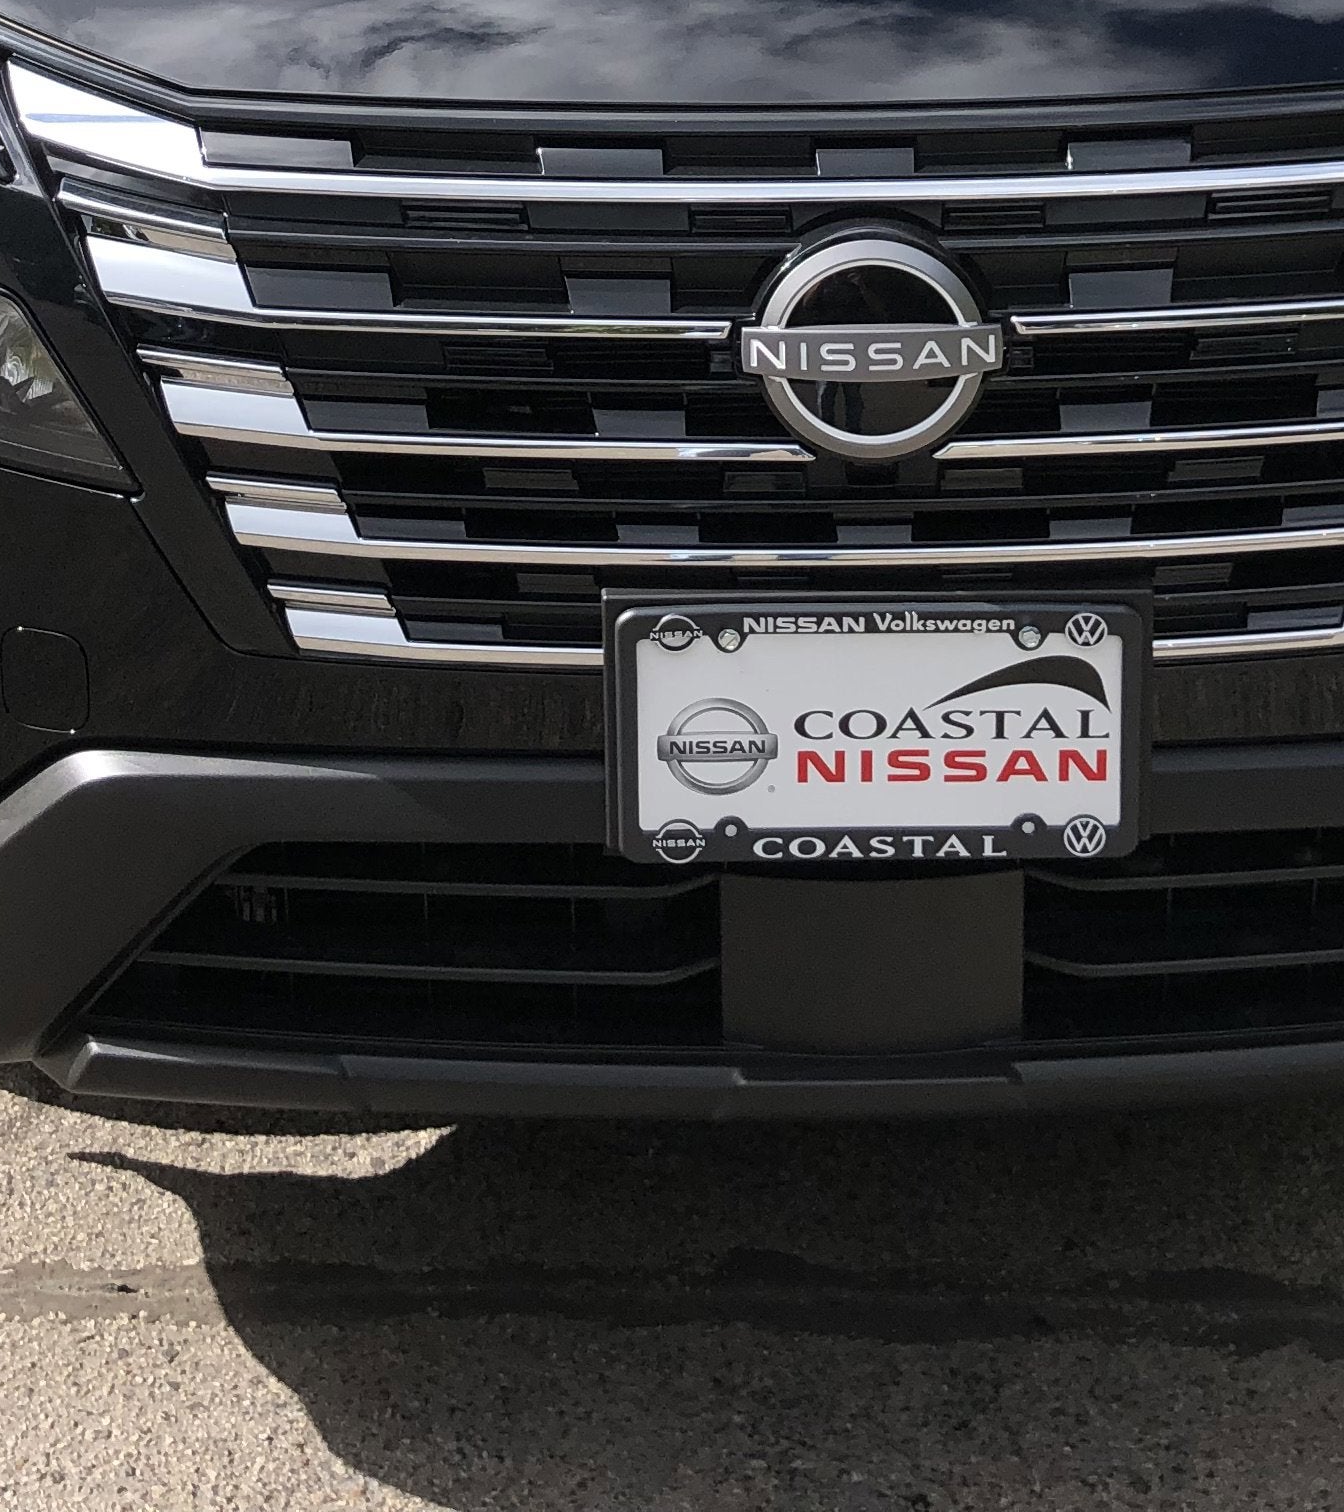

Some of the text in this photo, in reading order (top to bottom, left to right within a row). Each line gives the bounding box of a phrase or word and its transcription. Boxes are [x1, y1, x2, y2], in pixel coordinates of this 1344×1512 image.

[749, 334, 995, 372] NISSAN
[743, 611, 1015, 633] NISSAN Volkswagen
[649, 630, 703, 639] NISSAN
[794, 706, 1110, 740] COASTAL
[669, 740, 766, 755] NISSAN
[797, 749, 1107, 783] NISSAN
[653, 838, 705, 847] NISSAN
[753, 835, 1007, 858] COASTAL
